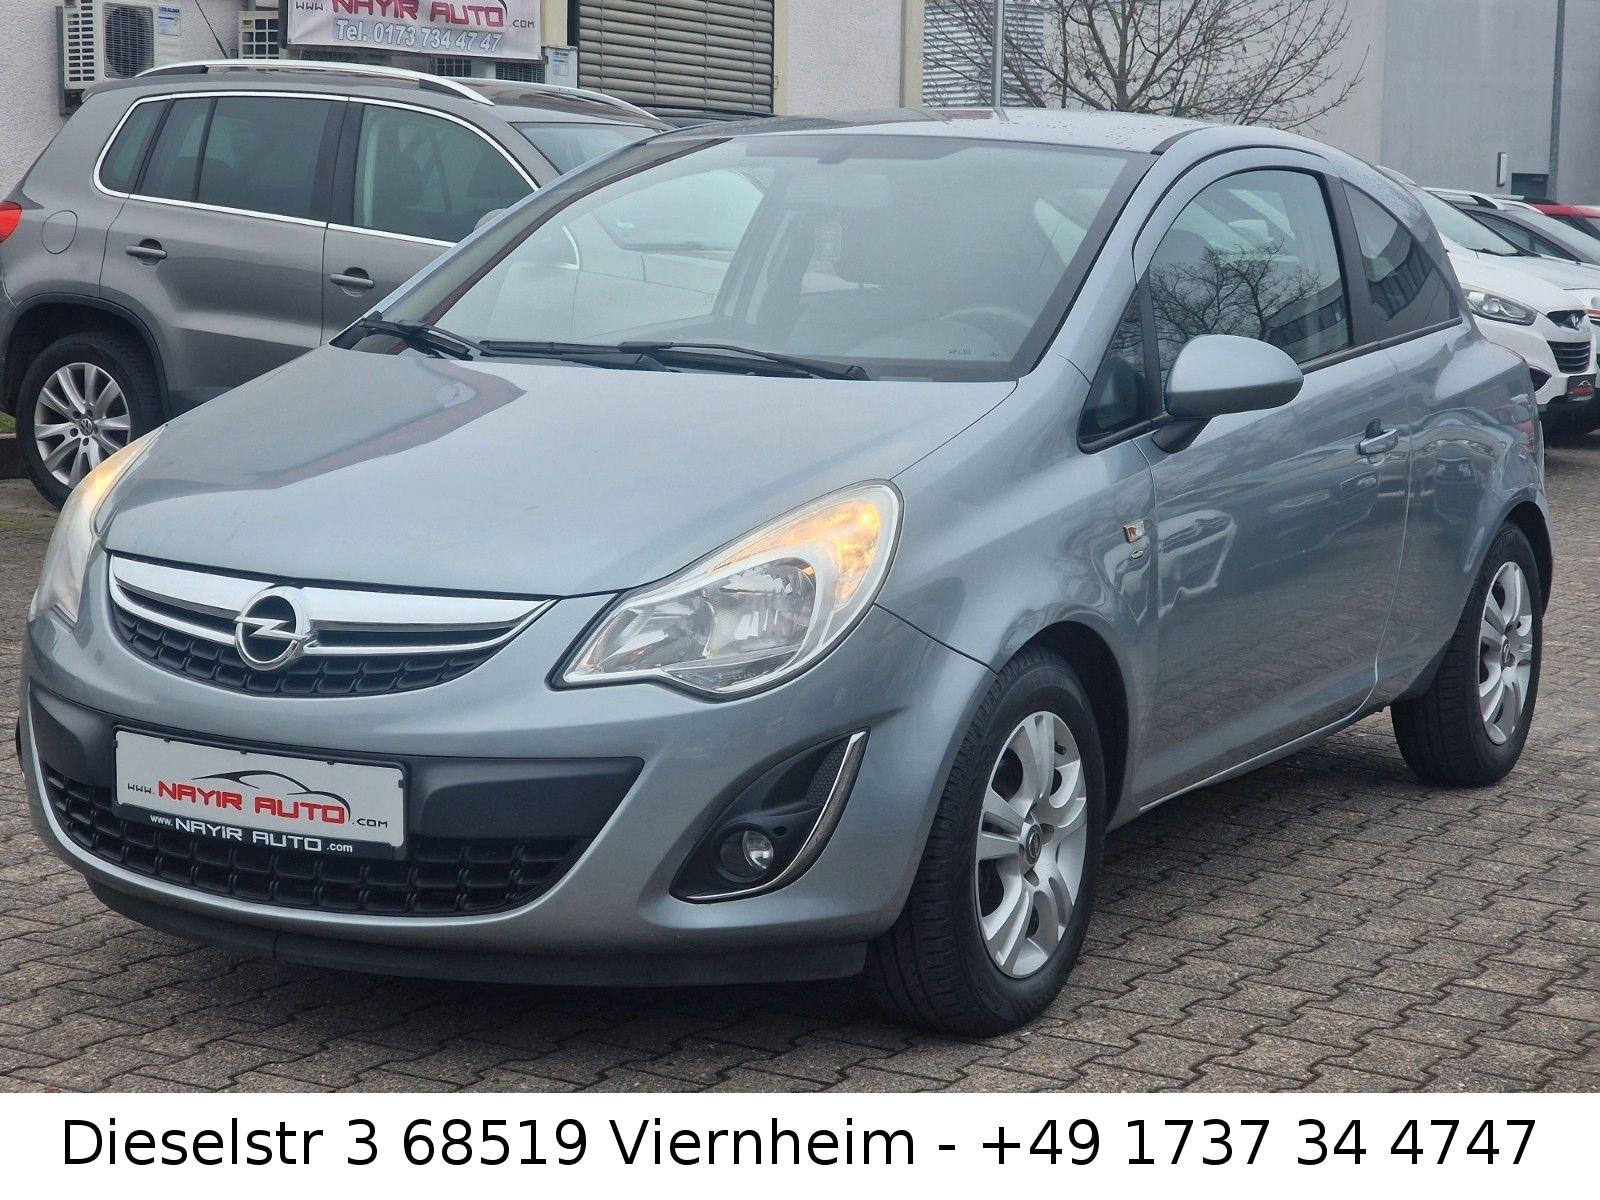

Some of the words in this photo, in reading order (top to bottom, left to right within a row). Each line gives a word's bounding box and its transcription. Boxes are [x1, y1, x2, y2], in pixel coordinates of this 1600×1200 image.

[429, 1, 504, 27] AUTO
[336, 18, 368, 42] Tel.
[373, 21, 417, 46] 0173
[420, 26, 453, 49] 734
[455, 30, 478, 52] 47
[479, 31, 503, 53] 47
[158, 780, 243, 811] NAYIR
[254, 796, 345, 825] AUTO
[175, 817, 243, 842] NAYIR
[252, 830, 322, 852] AUTO
[326, 842, 353, 853] .com
